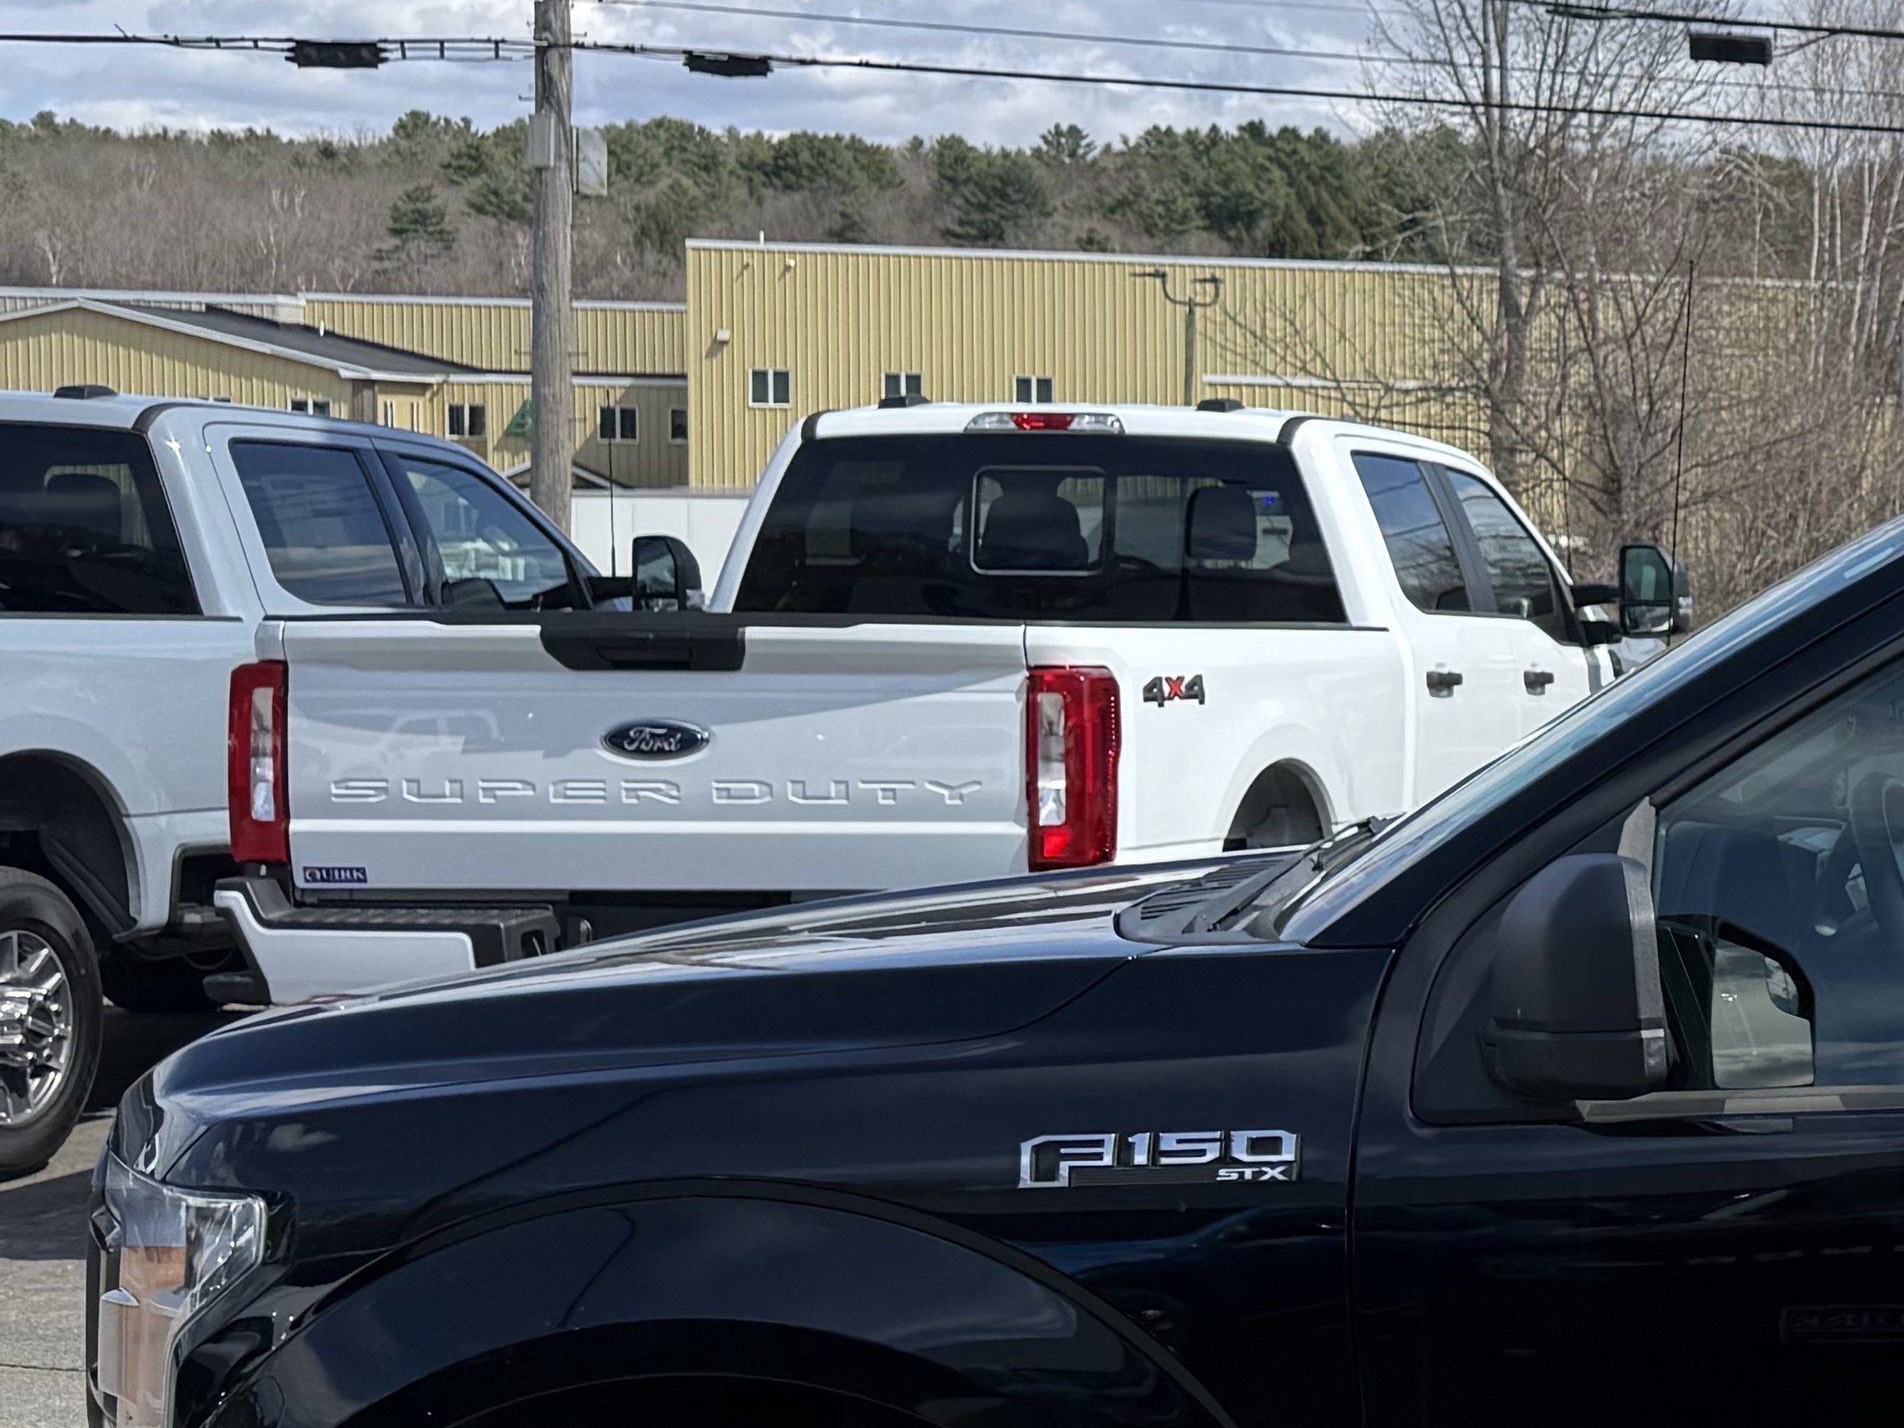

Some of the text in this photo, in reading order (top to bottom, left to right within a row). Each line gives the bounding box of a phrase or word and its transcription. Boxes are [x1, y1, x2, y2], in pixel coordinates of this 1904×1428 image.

[331, 779, 983, 806] SUPER DUTY
[304, 868, 365, 880] QUIRK
[1216, 1166, 1289, 1182] STX
